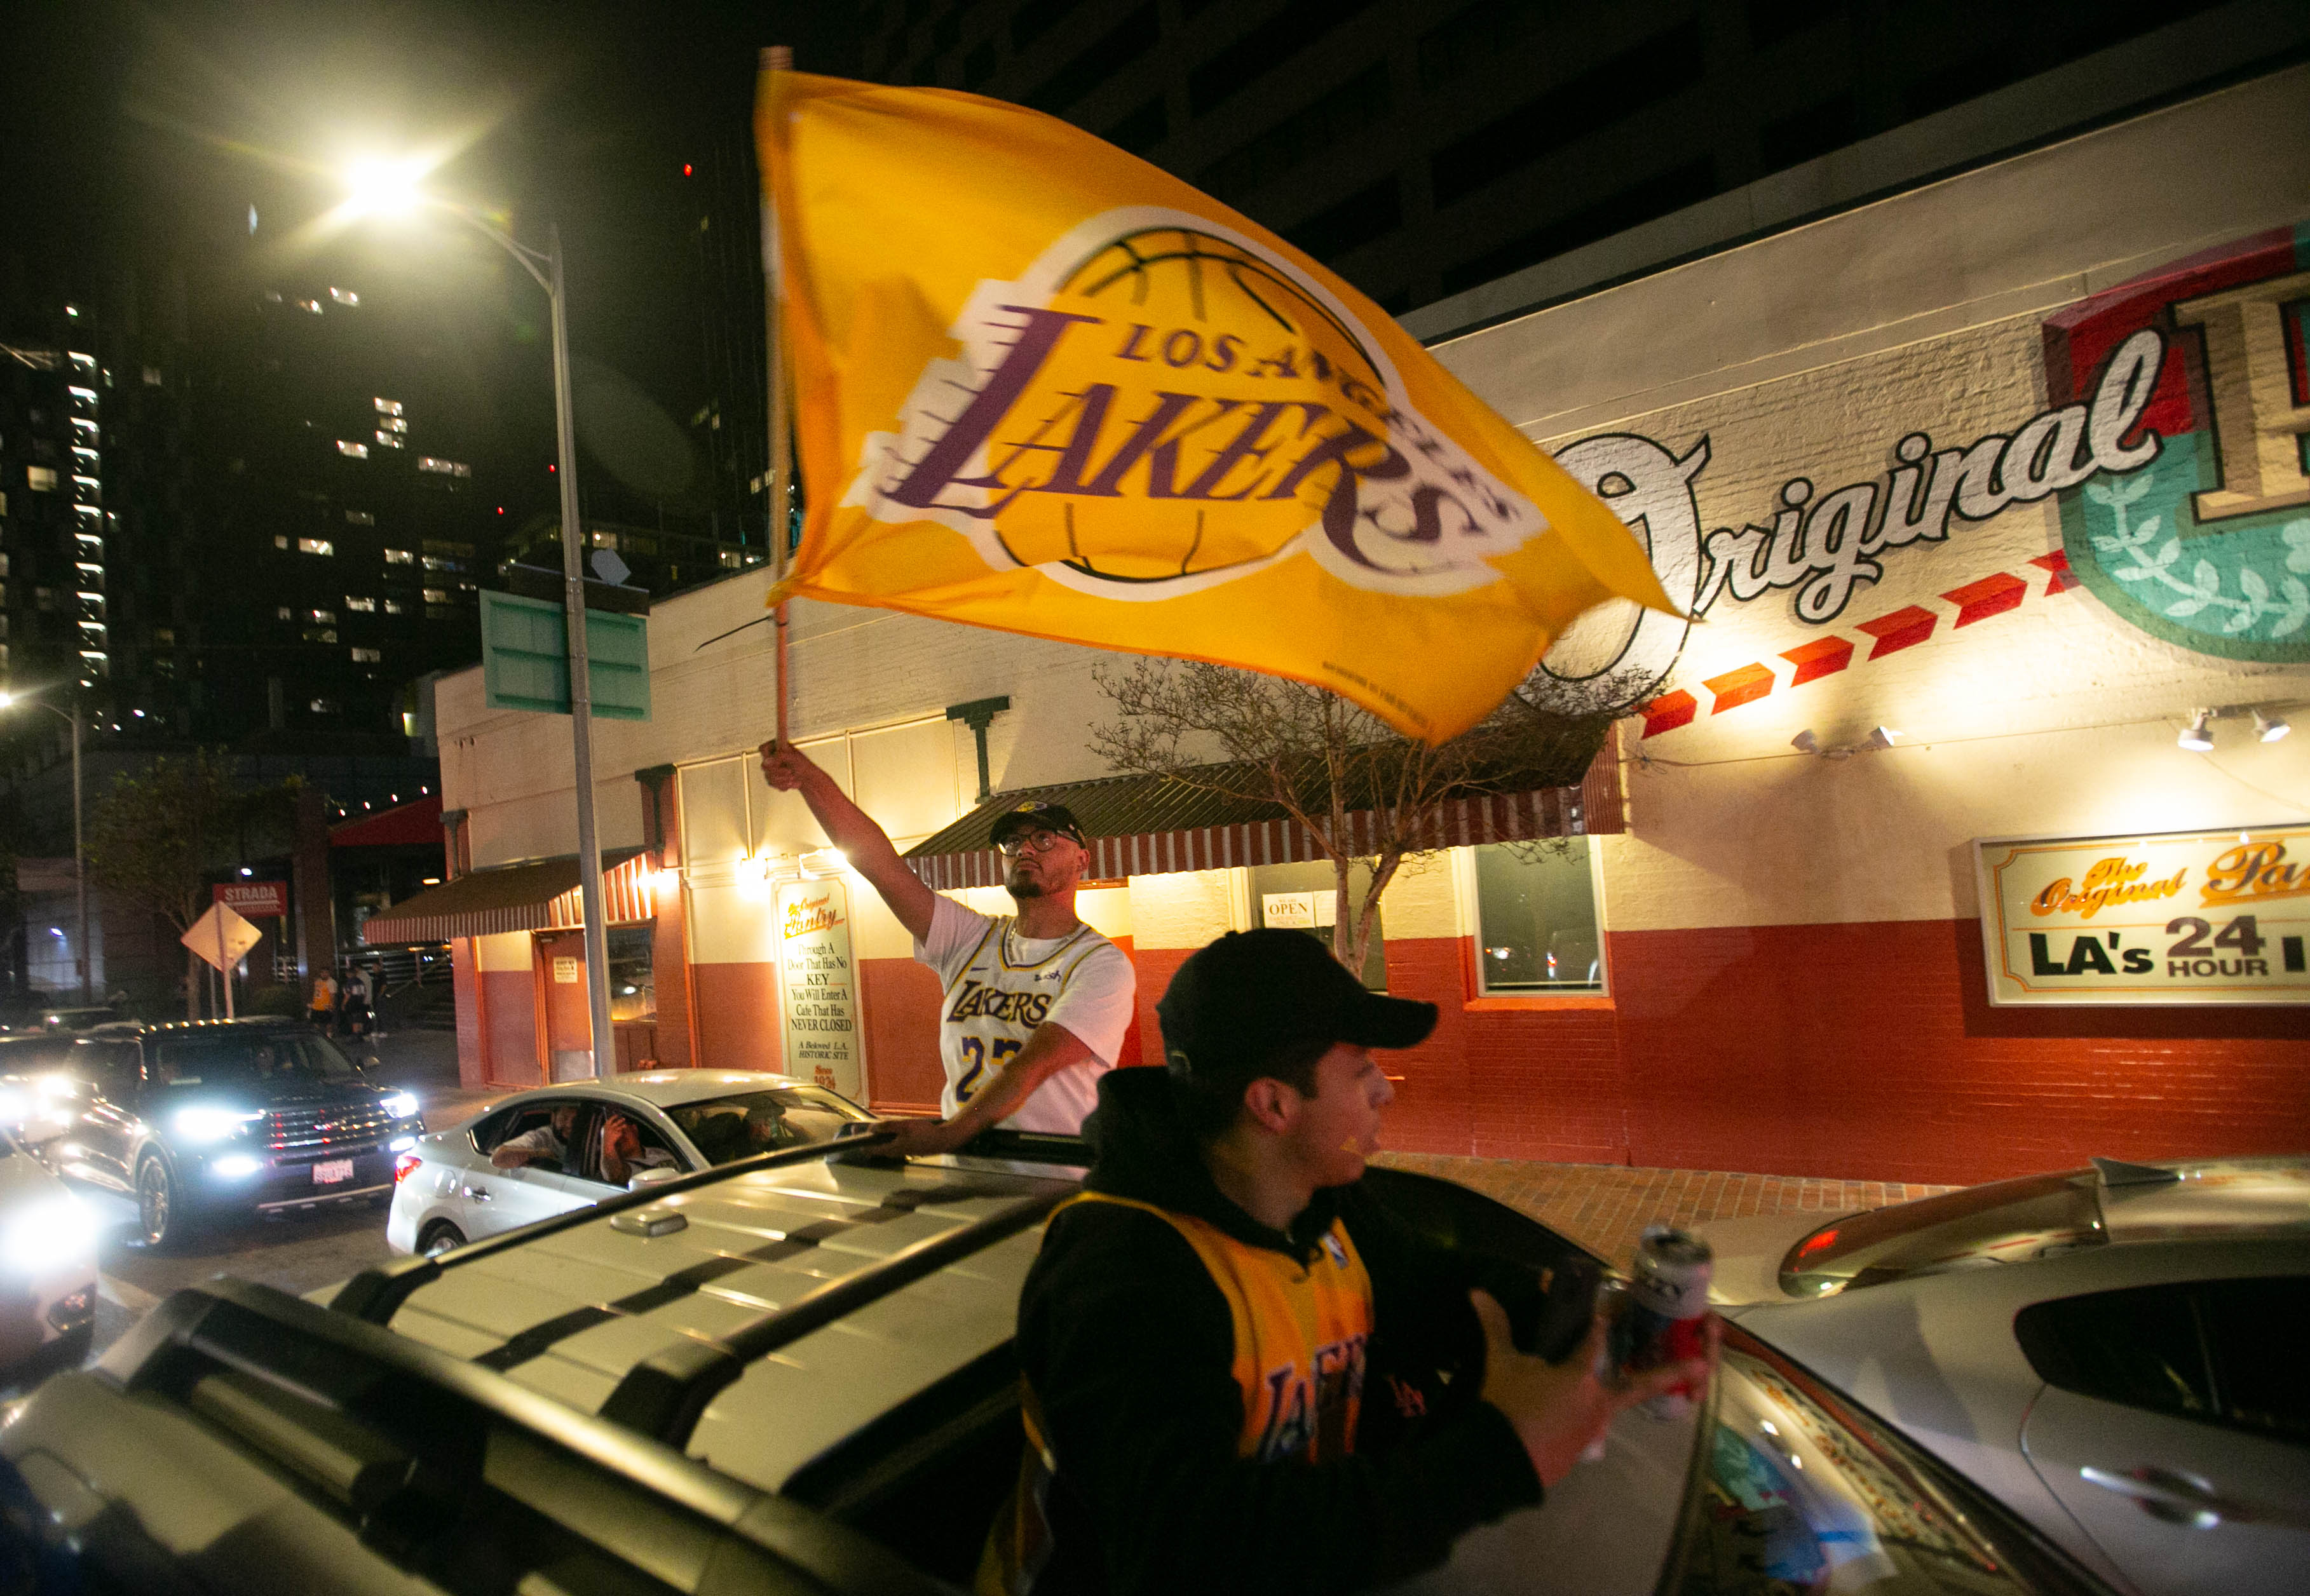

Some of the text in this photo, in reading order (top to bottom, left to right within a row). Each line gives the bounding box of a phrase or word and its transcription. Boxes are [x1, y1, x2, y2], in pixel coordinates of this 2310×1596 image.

[1115, 323, 1247, 375] LOS
[876, 304, 1490, 577] LAKERS
[2087, 856, 2149, 883] The
[224, 885, 278, 901] STRADA
[2035, 867, 2189, 915] Original
[1268, 902, 1307, 915] OPEN
[2166, 915, 2267, 957] 24
[798, 942, 835, 957] Through A
[2029, 931, 2154, 976] LA's
[788, 956, 847, 971] Door That Has No
[2168, 959, 2269, 978] HOUR
[807, 973, 829, 985] KEY
[791, 988, 848, 1001] You Will Enter A
[813, 1004, 829, 1017] That
[830, 1004, 845, 1017] Has
[946, 980, 1052, 1030] LAKERS
[792, 1018, 852, 1032] NEVER CLOSED
[799, 1041, 804, 1049] A
[806, 1041, 831, 1050] Beloved
[799, 1050, 849, 1060] HISTORIC SITE
